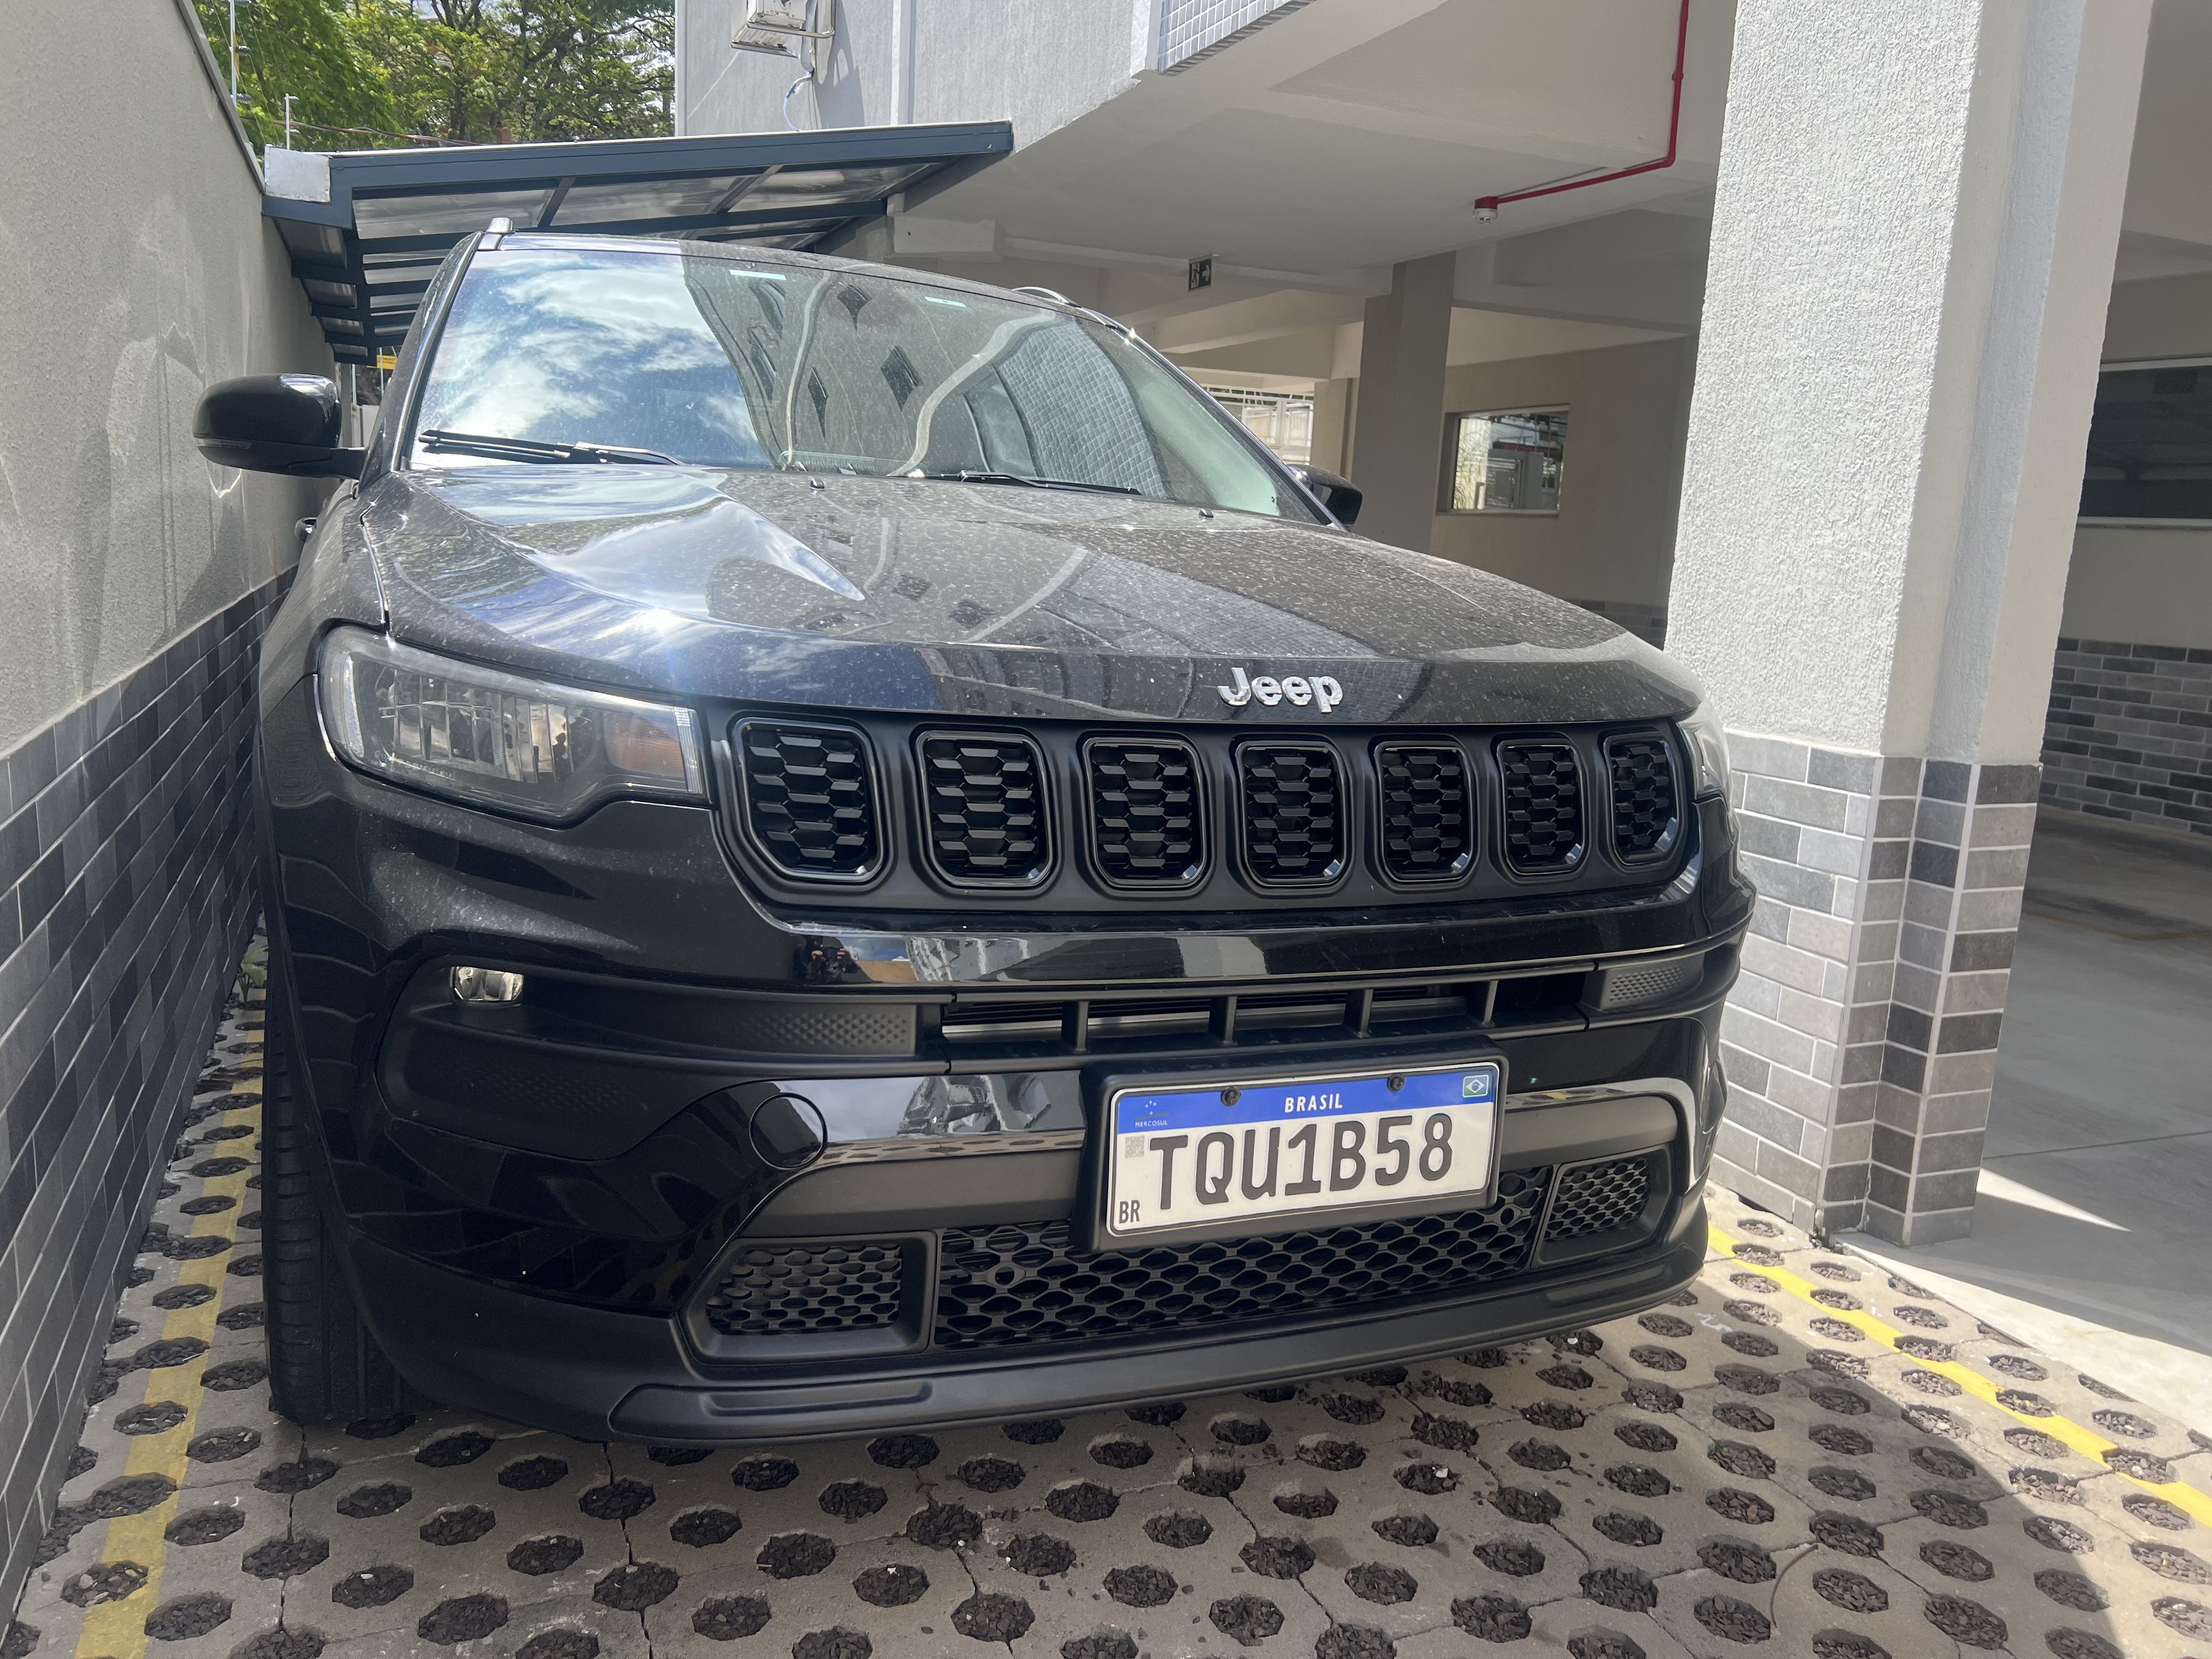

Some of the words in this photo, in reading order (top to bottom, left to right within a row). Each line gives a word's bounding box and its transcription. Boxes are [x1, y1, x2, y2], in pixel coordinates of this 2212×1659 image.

[1217, 667, 1343, 713] Jeep
[1284, 1093, 1343, 1113] BRASIL
[1135, 1119, 1168, 1128] MERCOSUL
[1149, 1113, 1453, 1210] TQU1B58
[1119, 1199, 1140, 1224] BR
